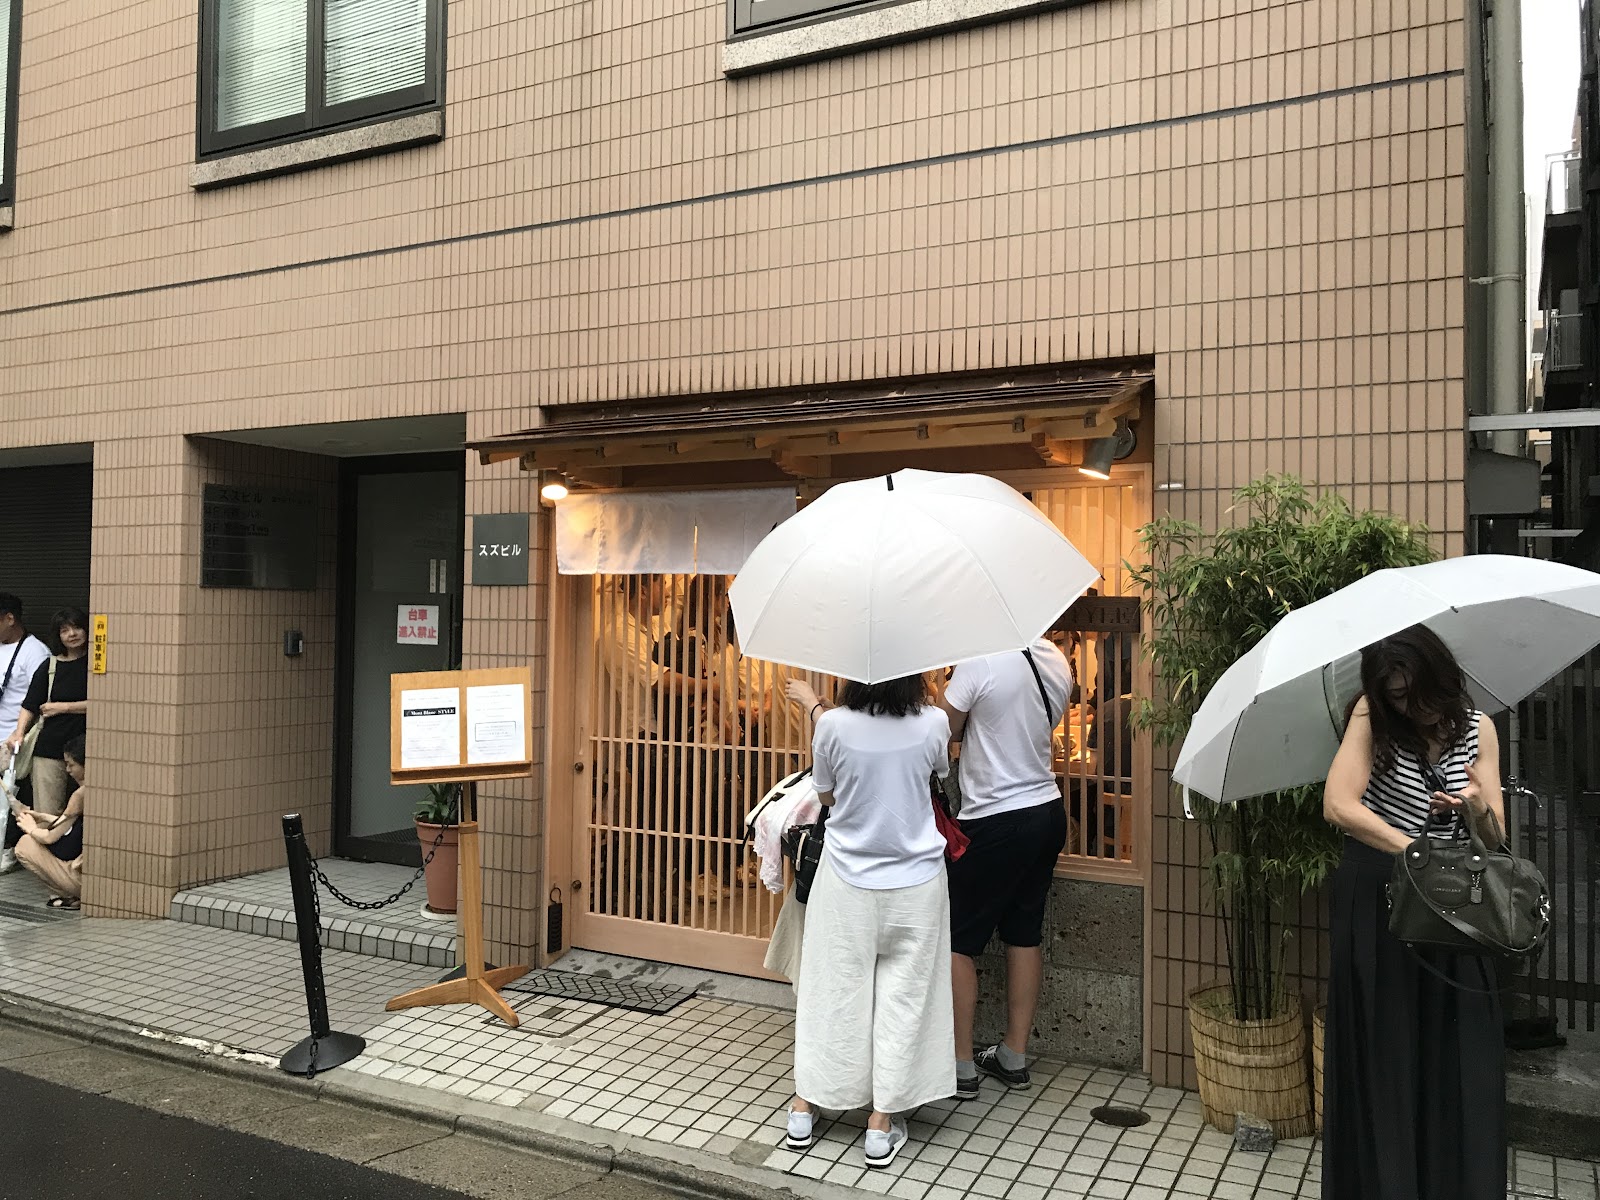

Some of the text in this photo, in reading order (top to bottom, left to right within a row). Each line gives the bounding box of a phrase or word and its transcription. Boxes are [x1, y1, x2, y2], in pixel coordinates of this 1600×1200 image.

[479, 543, 522, 557] スズビル
[408, 608, 428, 622] 台車
[398, 625, 437, 639] 進入禁止
[94, 635, 102, 671] 駐車禁止
